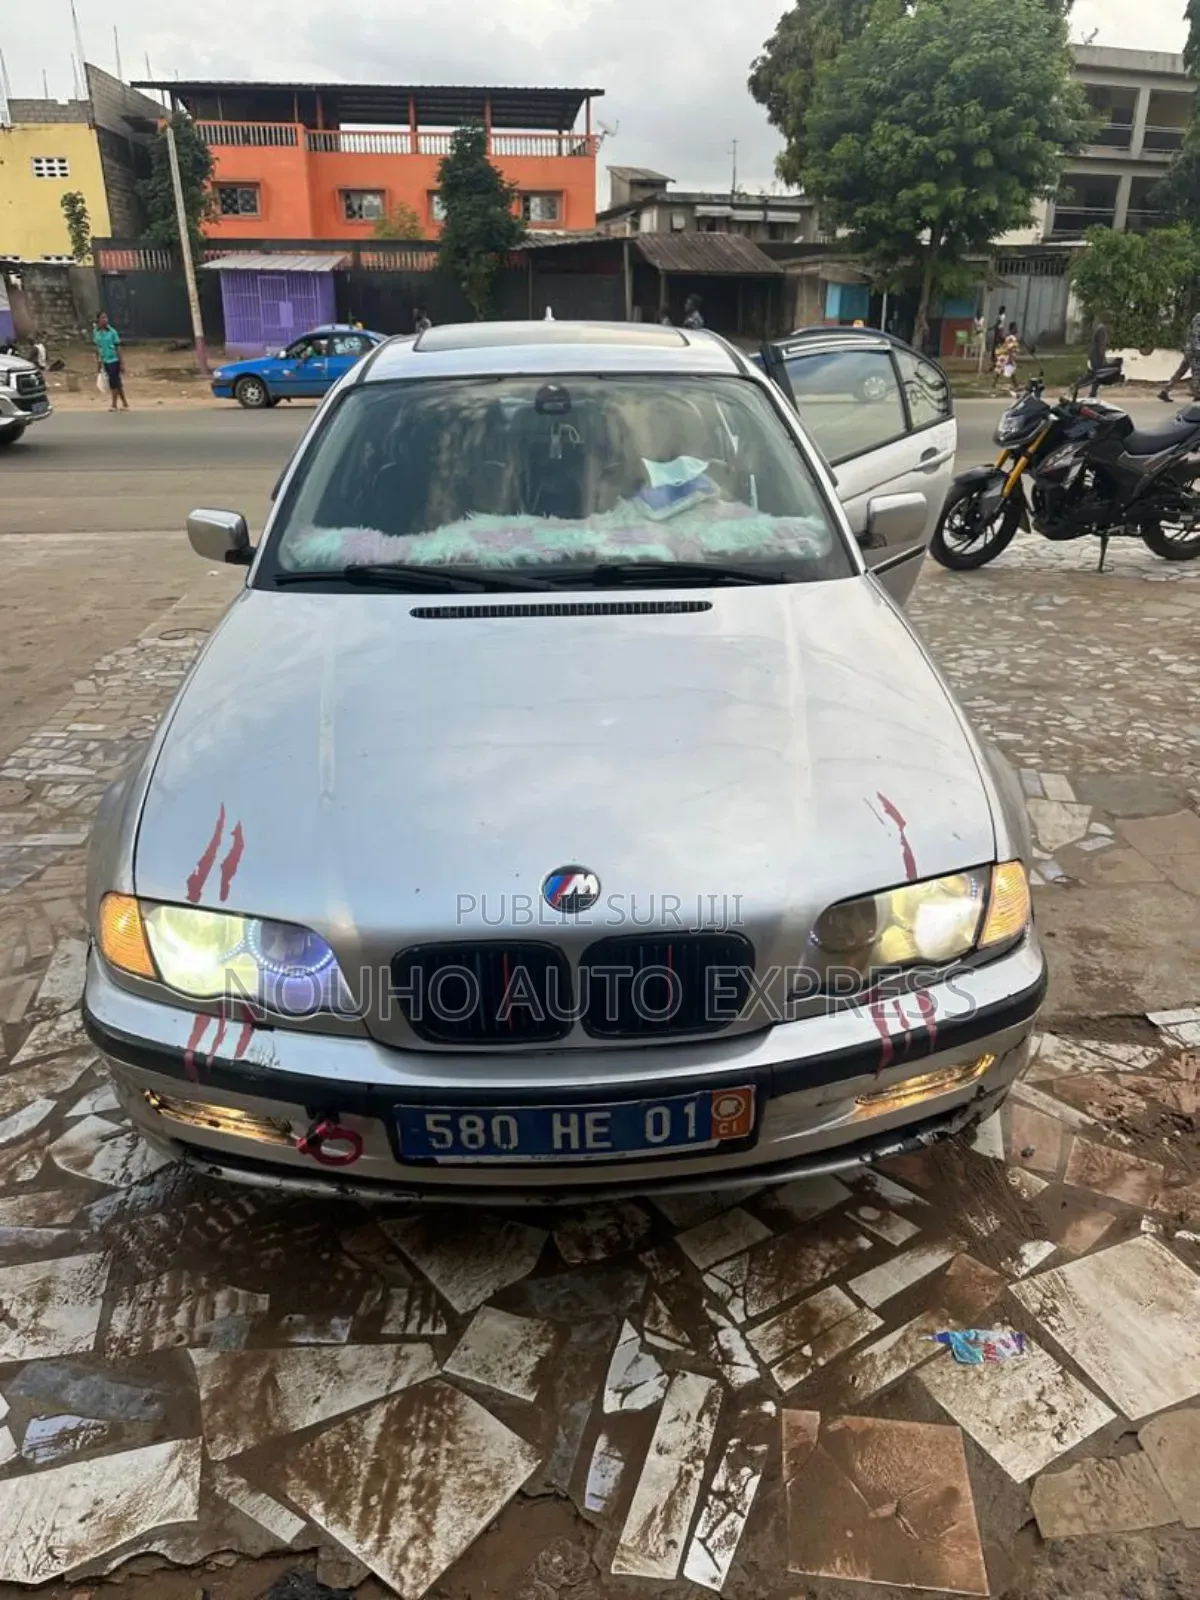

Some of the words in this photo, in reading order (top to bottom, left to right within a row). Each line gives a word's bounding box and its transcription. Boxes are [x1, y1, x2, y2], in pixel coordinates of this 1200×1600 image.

[424, 1113, 519, 1150] 580
[551, 1111, 612, 1149] HE
[645, 1100, 697, 1142] 01
